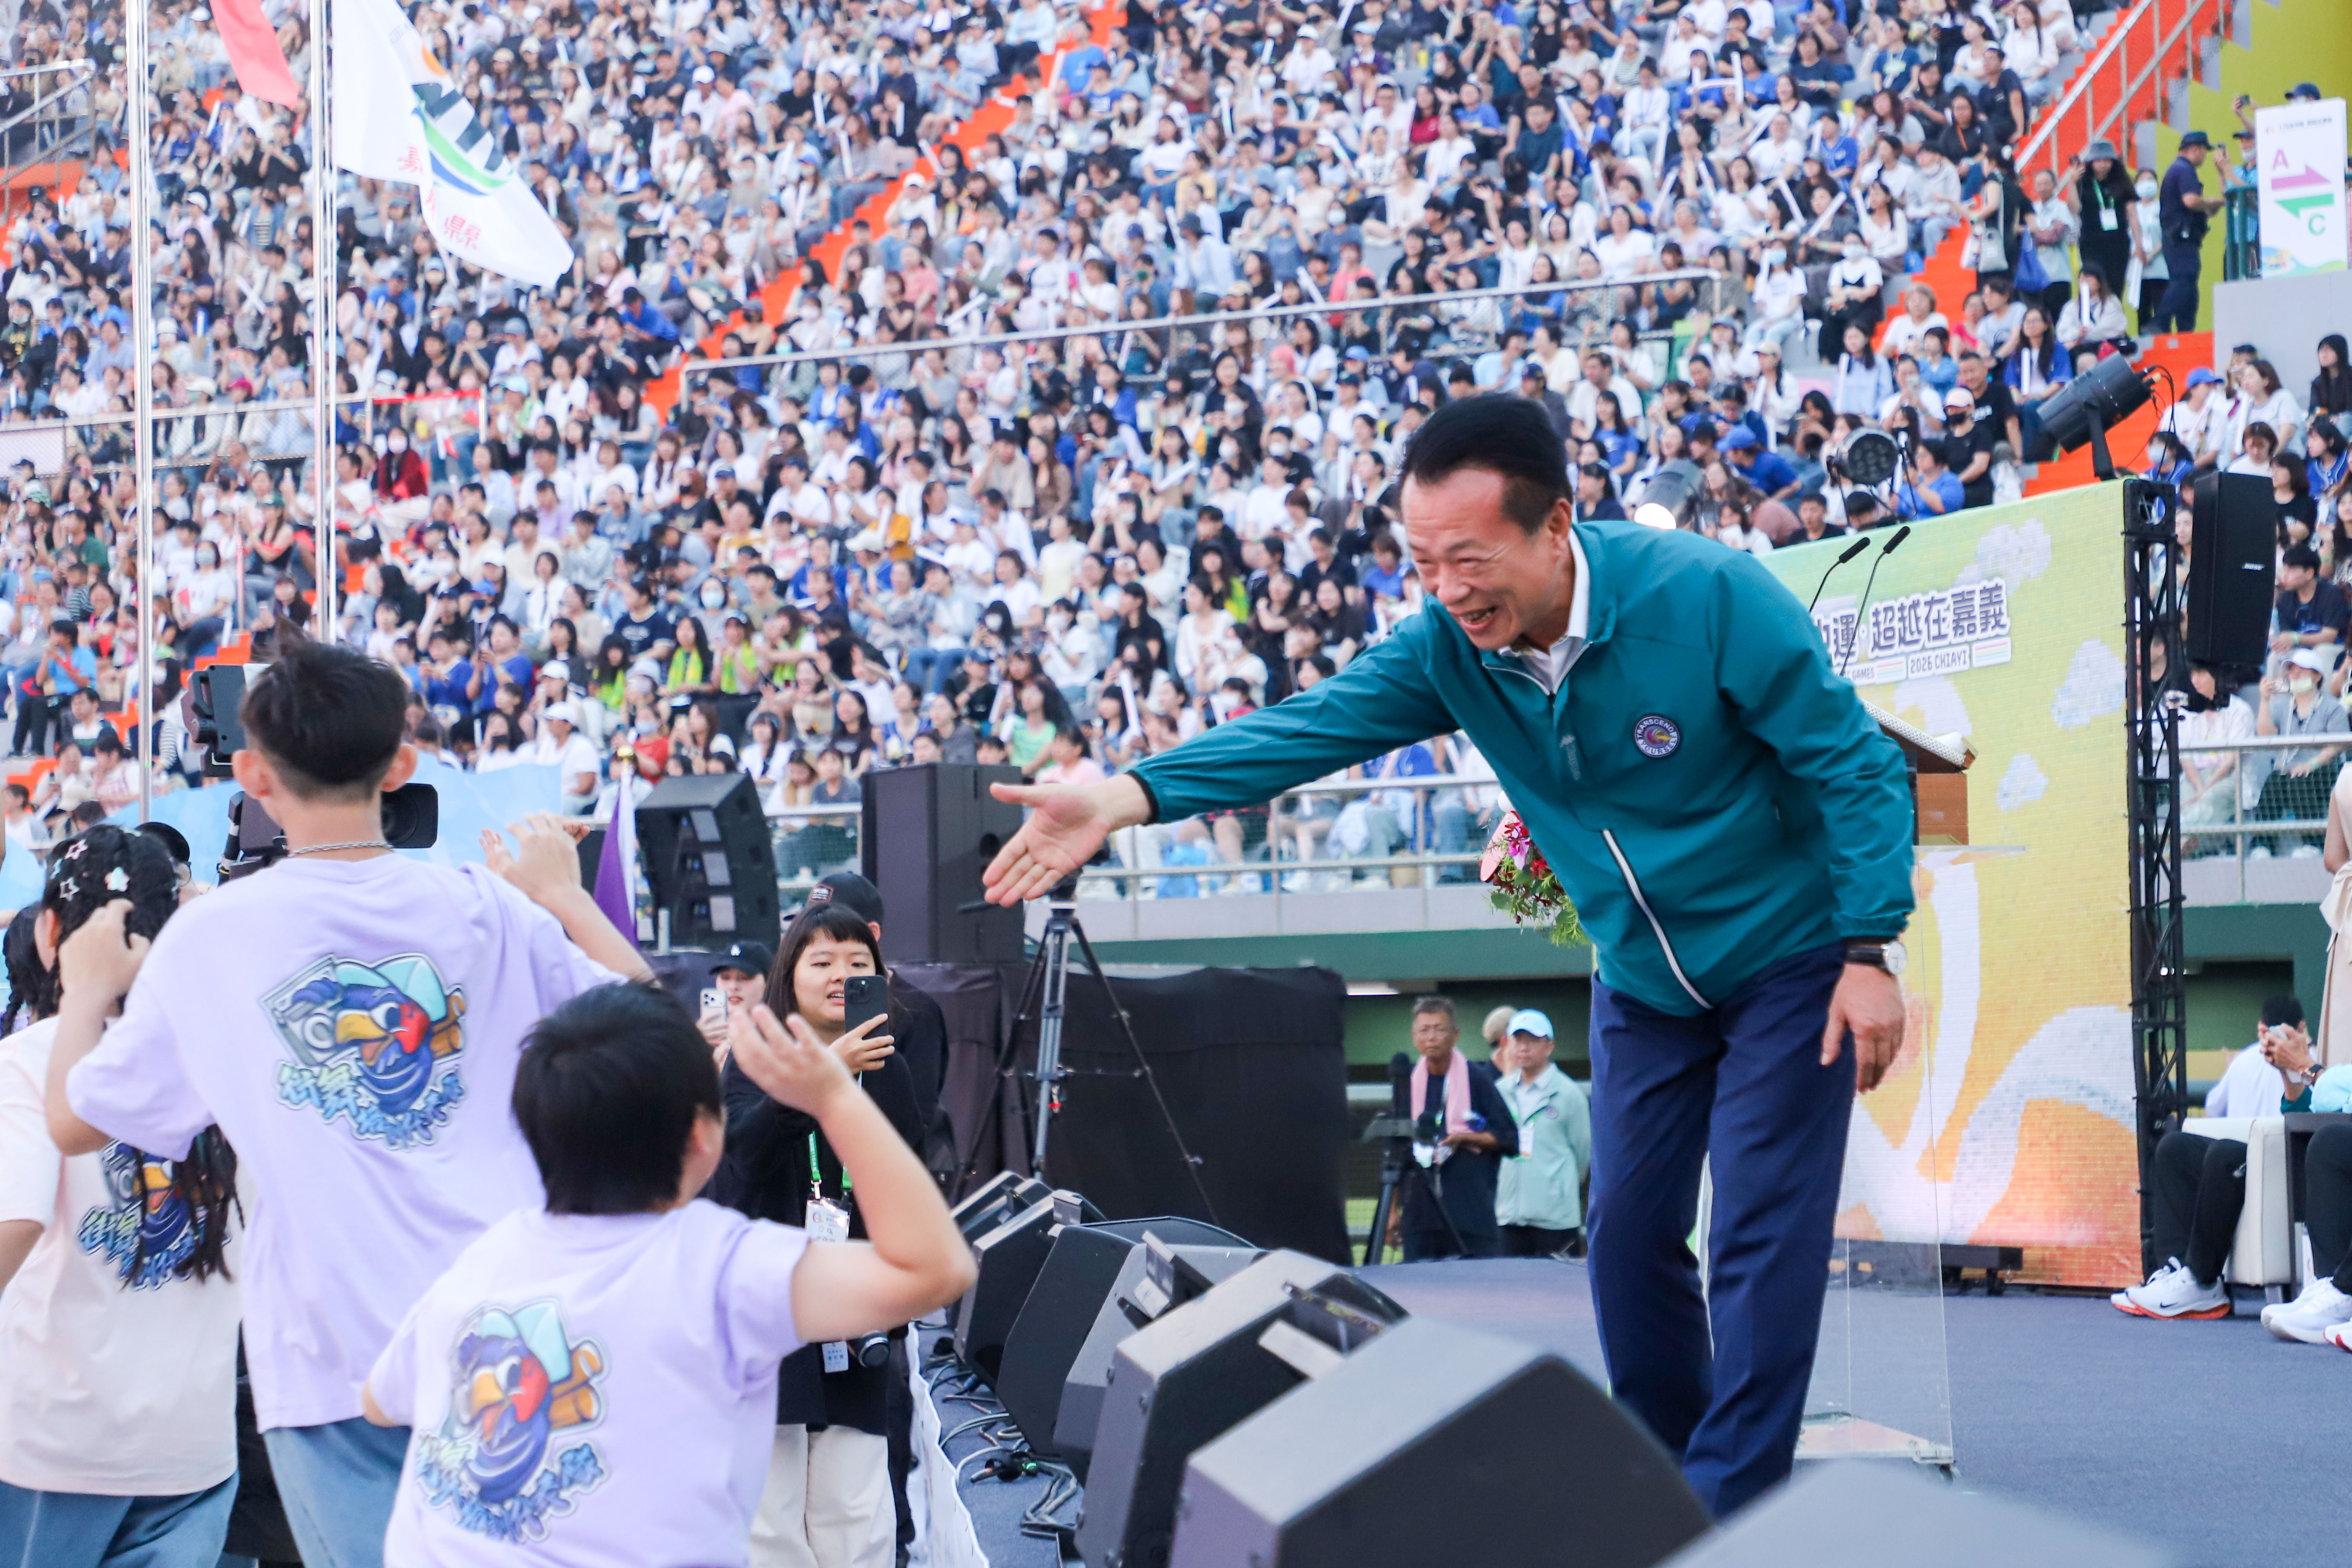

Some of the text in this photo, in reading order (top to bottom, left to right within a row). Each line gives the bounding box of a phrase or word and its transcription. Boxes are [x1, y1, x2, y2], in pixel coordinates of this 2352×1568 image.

[2272, 149, 2289, 170] A
[2308, 213, 2326, 235] C
[1852, 668, 1875, 679] GAMES
[1910, 655, 1933, 674] 2026
[1935, 650, 1967, 669] CHIAYI
[1636, 719, 1674, 739] TRANSCEND
[1639, 733, 1677, 754] YOURSELF
